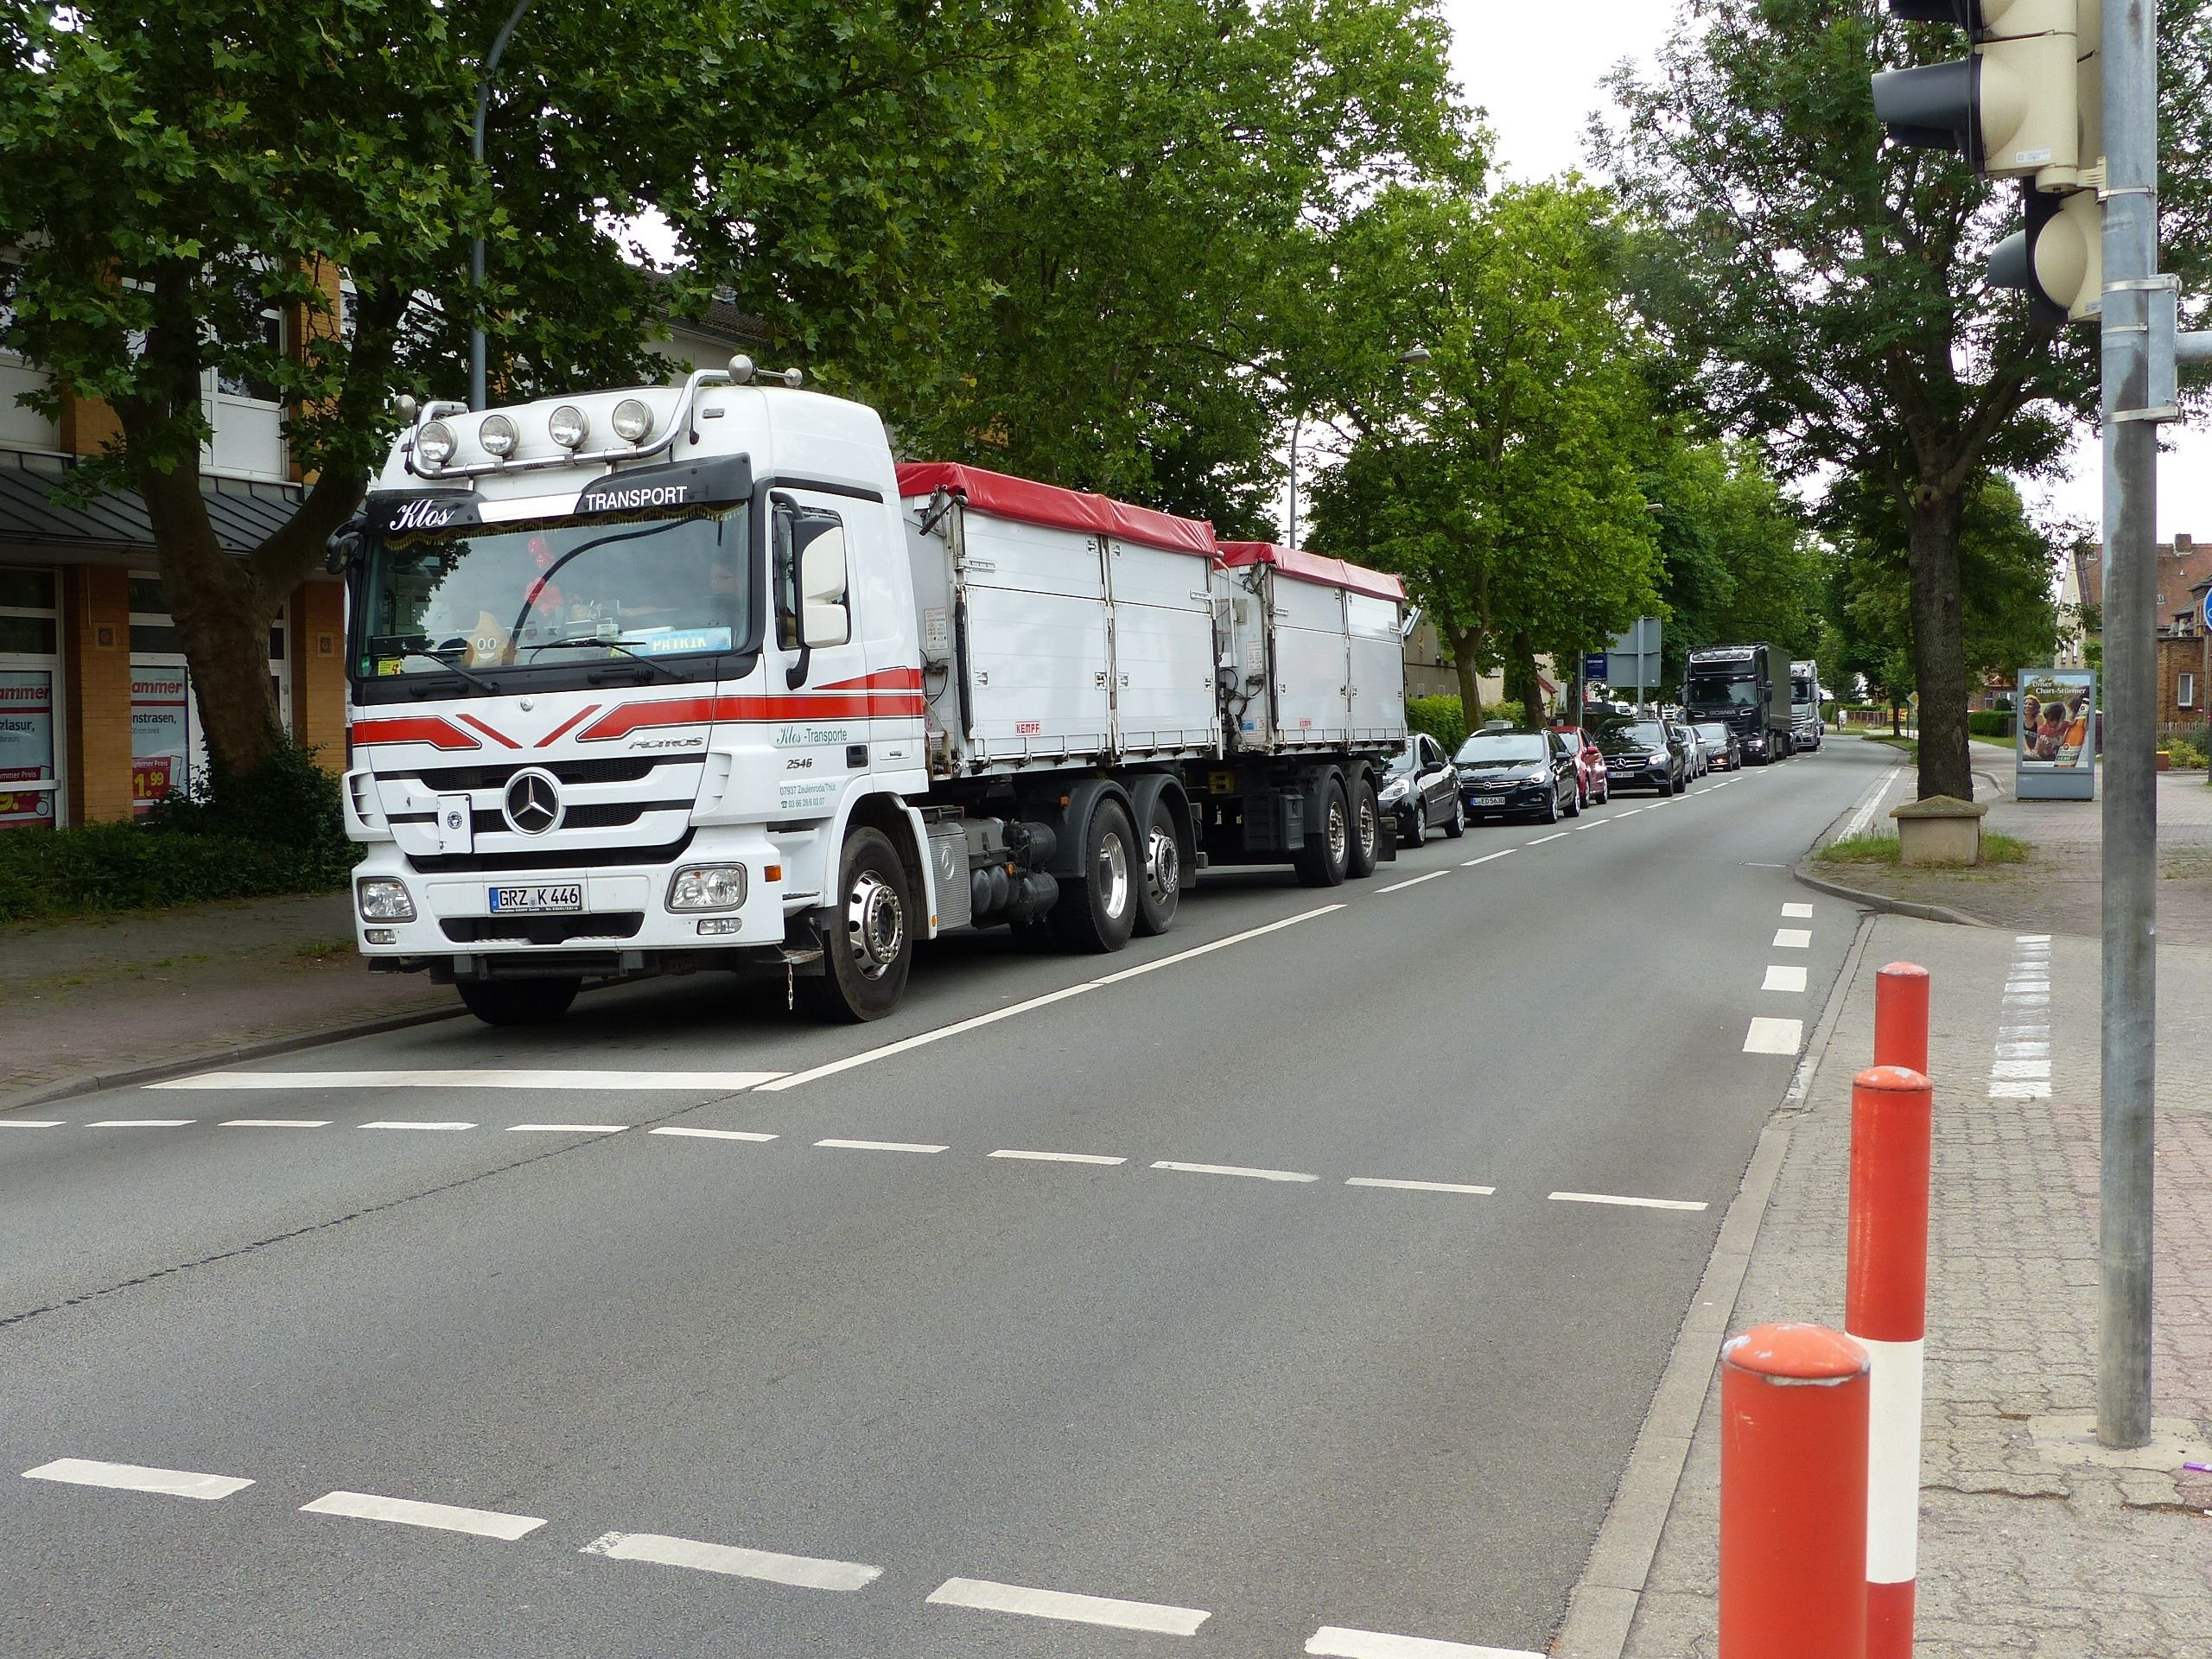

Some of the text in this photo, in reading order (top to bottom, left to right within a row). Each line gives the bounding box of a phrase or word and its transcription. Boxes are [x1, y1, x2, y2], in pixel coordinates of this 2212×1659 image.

[586, 486, 688, 511] TRANSPORT
[390, 499, 454, 531] Klos
[652, 636, 707, 652] PATRIK
[776, 726, 848, 745] Klos -Transporte
[1017, 723, 1039, 734] KEMPF
[786, 758, 813, 770] 2546
[779, 786, 797, 796] 07937
[499, 889, 528, 906] GRZ
[537, 888, 548, 905] K
[551, 887, 578, 904] 446
